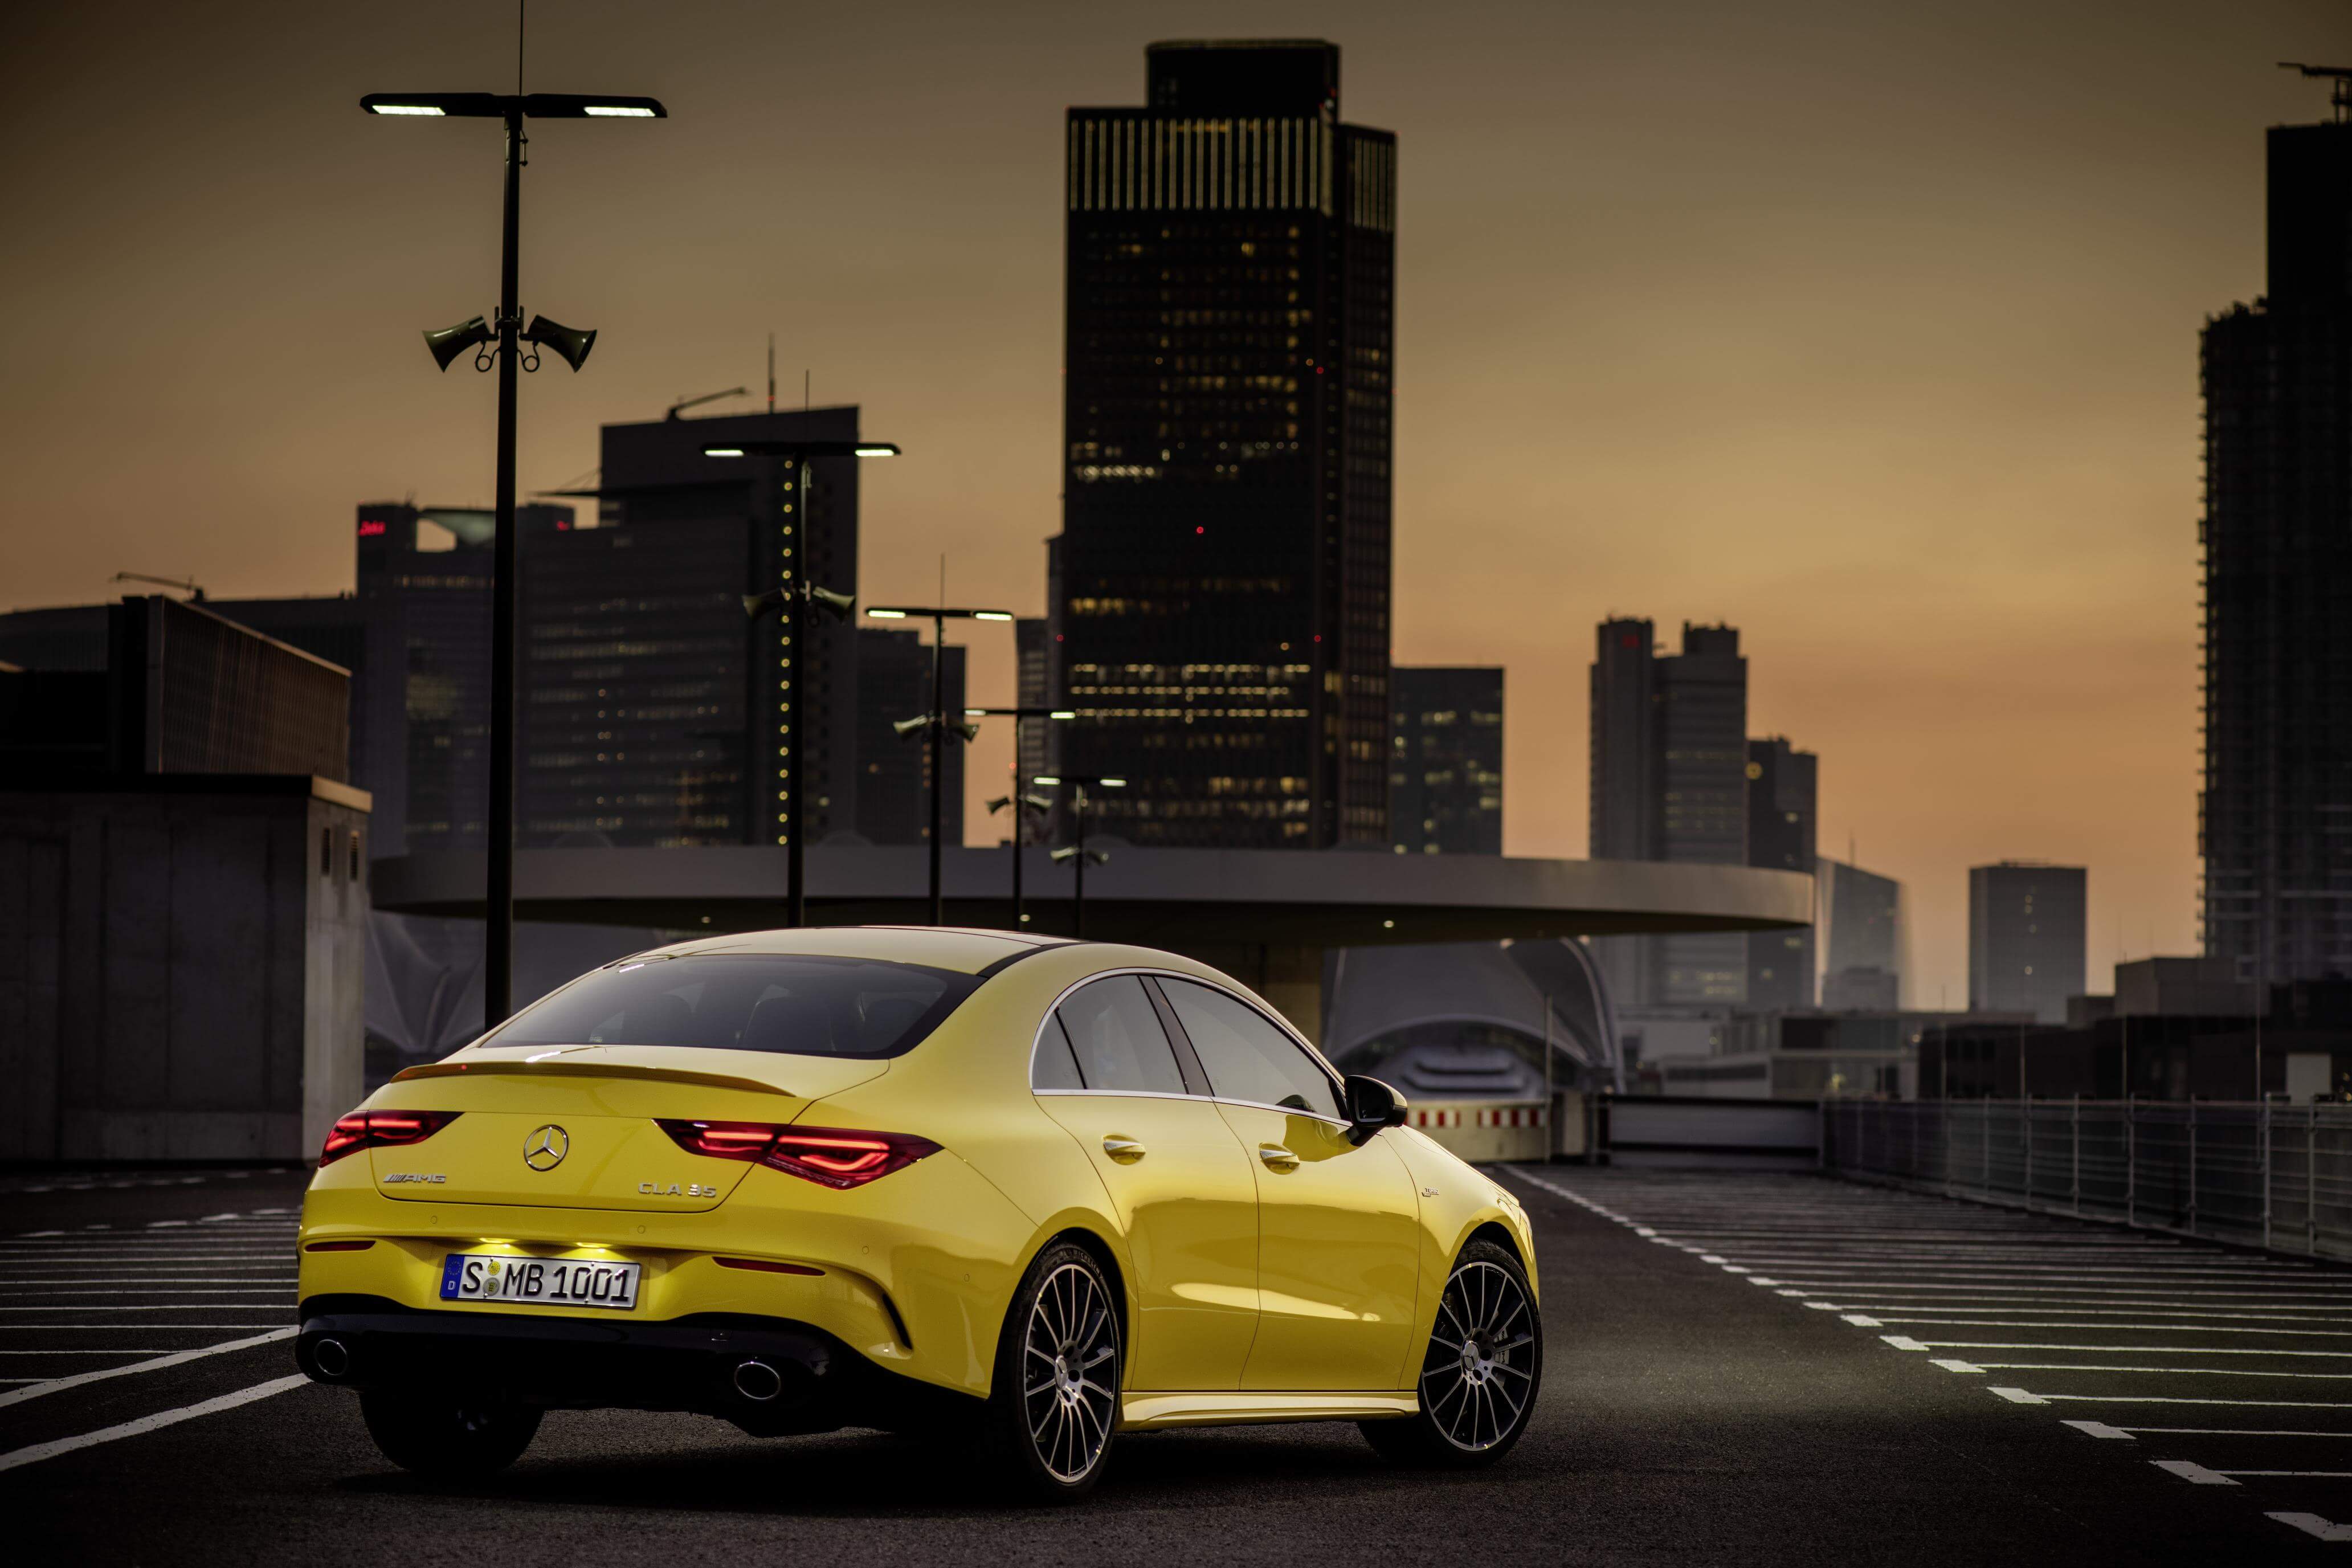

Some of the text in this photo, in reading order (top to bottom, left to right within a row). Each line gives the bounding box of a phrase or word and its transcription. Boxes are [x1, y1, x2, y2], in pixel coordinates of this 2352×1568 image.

[400, 1174, 446, 1183] AMG
[638, 1183, 716, 1198] CLA 35
[448, 1280, 455, 1290] D
[463, 1261, 629, 1301] S MB 1001
